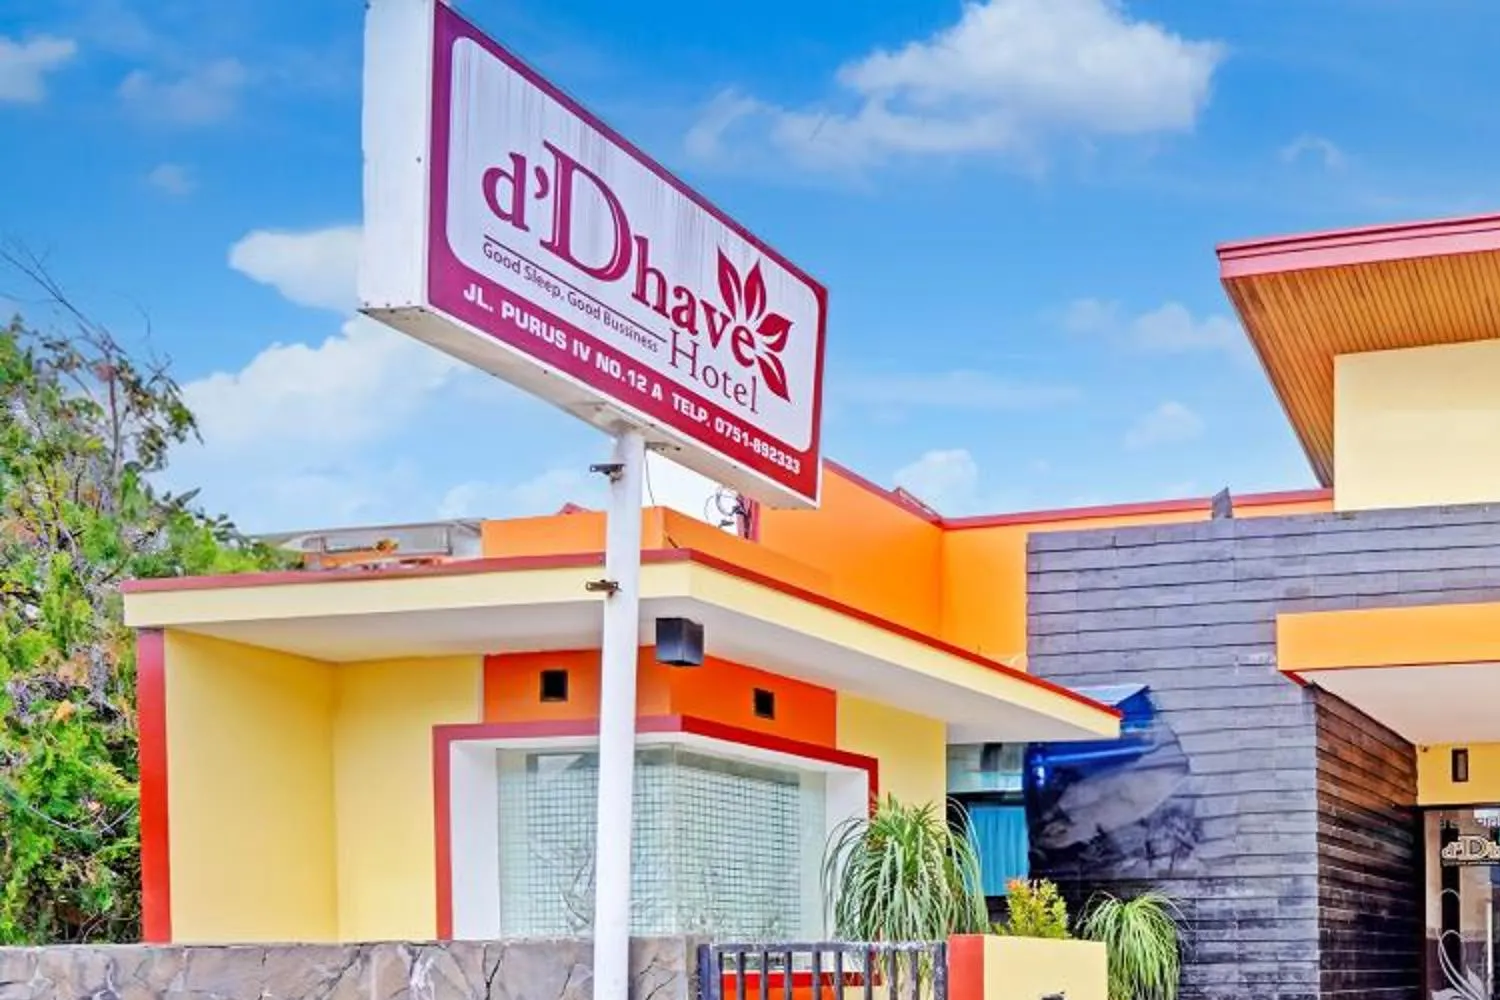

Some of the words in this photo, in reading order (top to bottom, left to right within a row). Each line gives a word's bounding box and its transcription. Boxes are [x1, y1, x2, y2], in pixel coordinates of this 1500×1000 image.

[482, 241, 521, 275] Good
[567, 291, 600, 321] Good
[603, 311, 659, 353] Bussiness
[463, 283, 494, 313] JL.
[501, 300, 568, 351] PURUS
[572, 339, 591, 362] IV
[651, 383, 663, 401] A
[672, 393, 711, 428] TELP.
[714, 416, 800, 475] 0751-892333
[669, 328, 758, 414] Hotel
